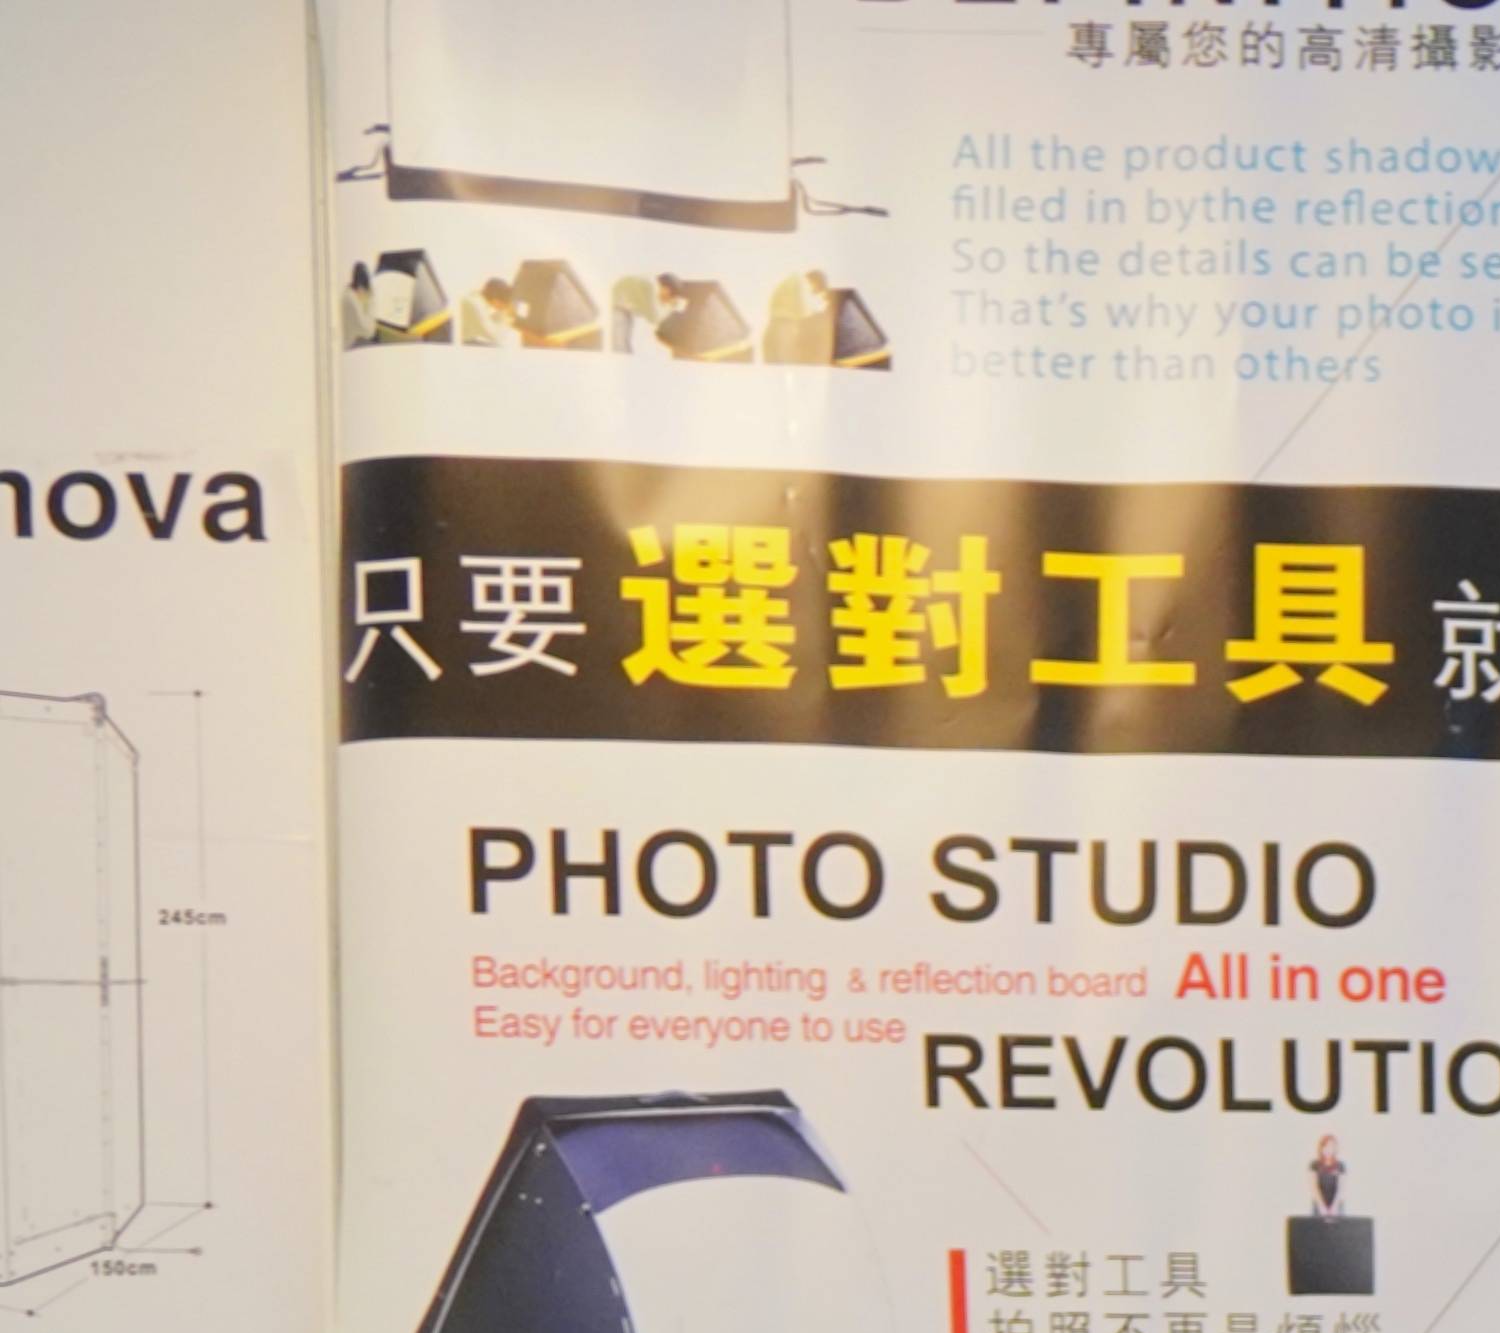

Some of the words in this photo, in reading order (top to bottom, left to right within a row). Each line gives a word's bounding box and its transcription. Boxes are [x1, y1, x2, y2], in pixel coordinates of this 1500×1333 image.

[952, 134, 1011, 170] All
[1031, 134, 1105, 172] the
[1124, 135, 1308, 179] product
[952, 188, 1067, 224] filled
[1087, 190, 1125, 224] in
[952, 239, 1005, 274] So
[1026, 240, 1102, 277] the
[1119, 240, 1271, 277] details
[1289, 250, 1368, 279] can
[1387, 243, 1441, 280] be
[1106, 294, 1195, 336] why
[1215, 301, 1319, 336] your
[1338, 297, 1475, 341] photo
[951, 346, 1095, 381] better
[1113, 345, 1214, 382] than
[1236, 348, 1382, 384] others
[469, 828, 886, 920] PHOTO
[930, 836, 1377, 929] STUDIO
[158, 908, 227, 926] 245cm
[472, 956, 692, 997] Background,
[705, 961, 828, 1002] lighting
[847, 968, 868, 994] &
[879, 964, 1037, 998] reflection
[1048, 966, 1148, 999] board
[1175, 952, 1248, 1000] All
[1270, 954, 1318, 1001] in
[1338, 966, 1447, 1004] one
[473, 1005, 562, 1047] Easy
[571, 1006, 618, 1040] for
[628, 1014, 790, 1048] everyone
[799, 1012, 833, 1043] to
[845, 1015, 906, 1045] use
[987, 1250, 1207, 1298] 選對工具
